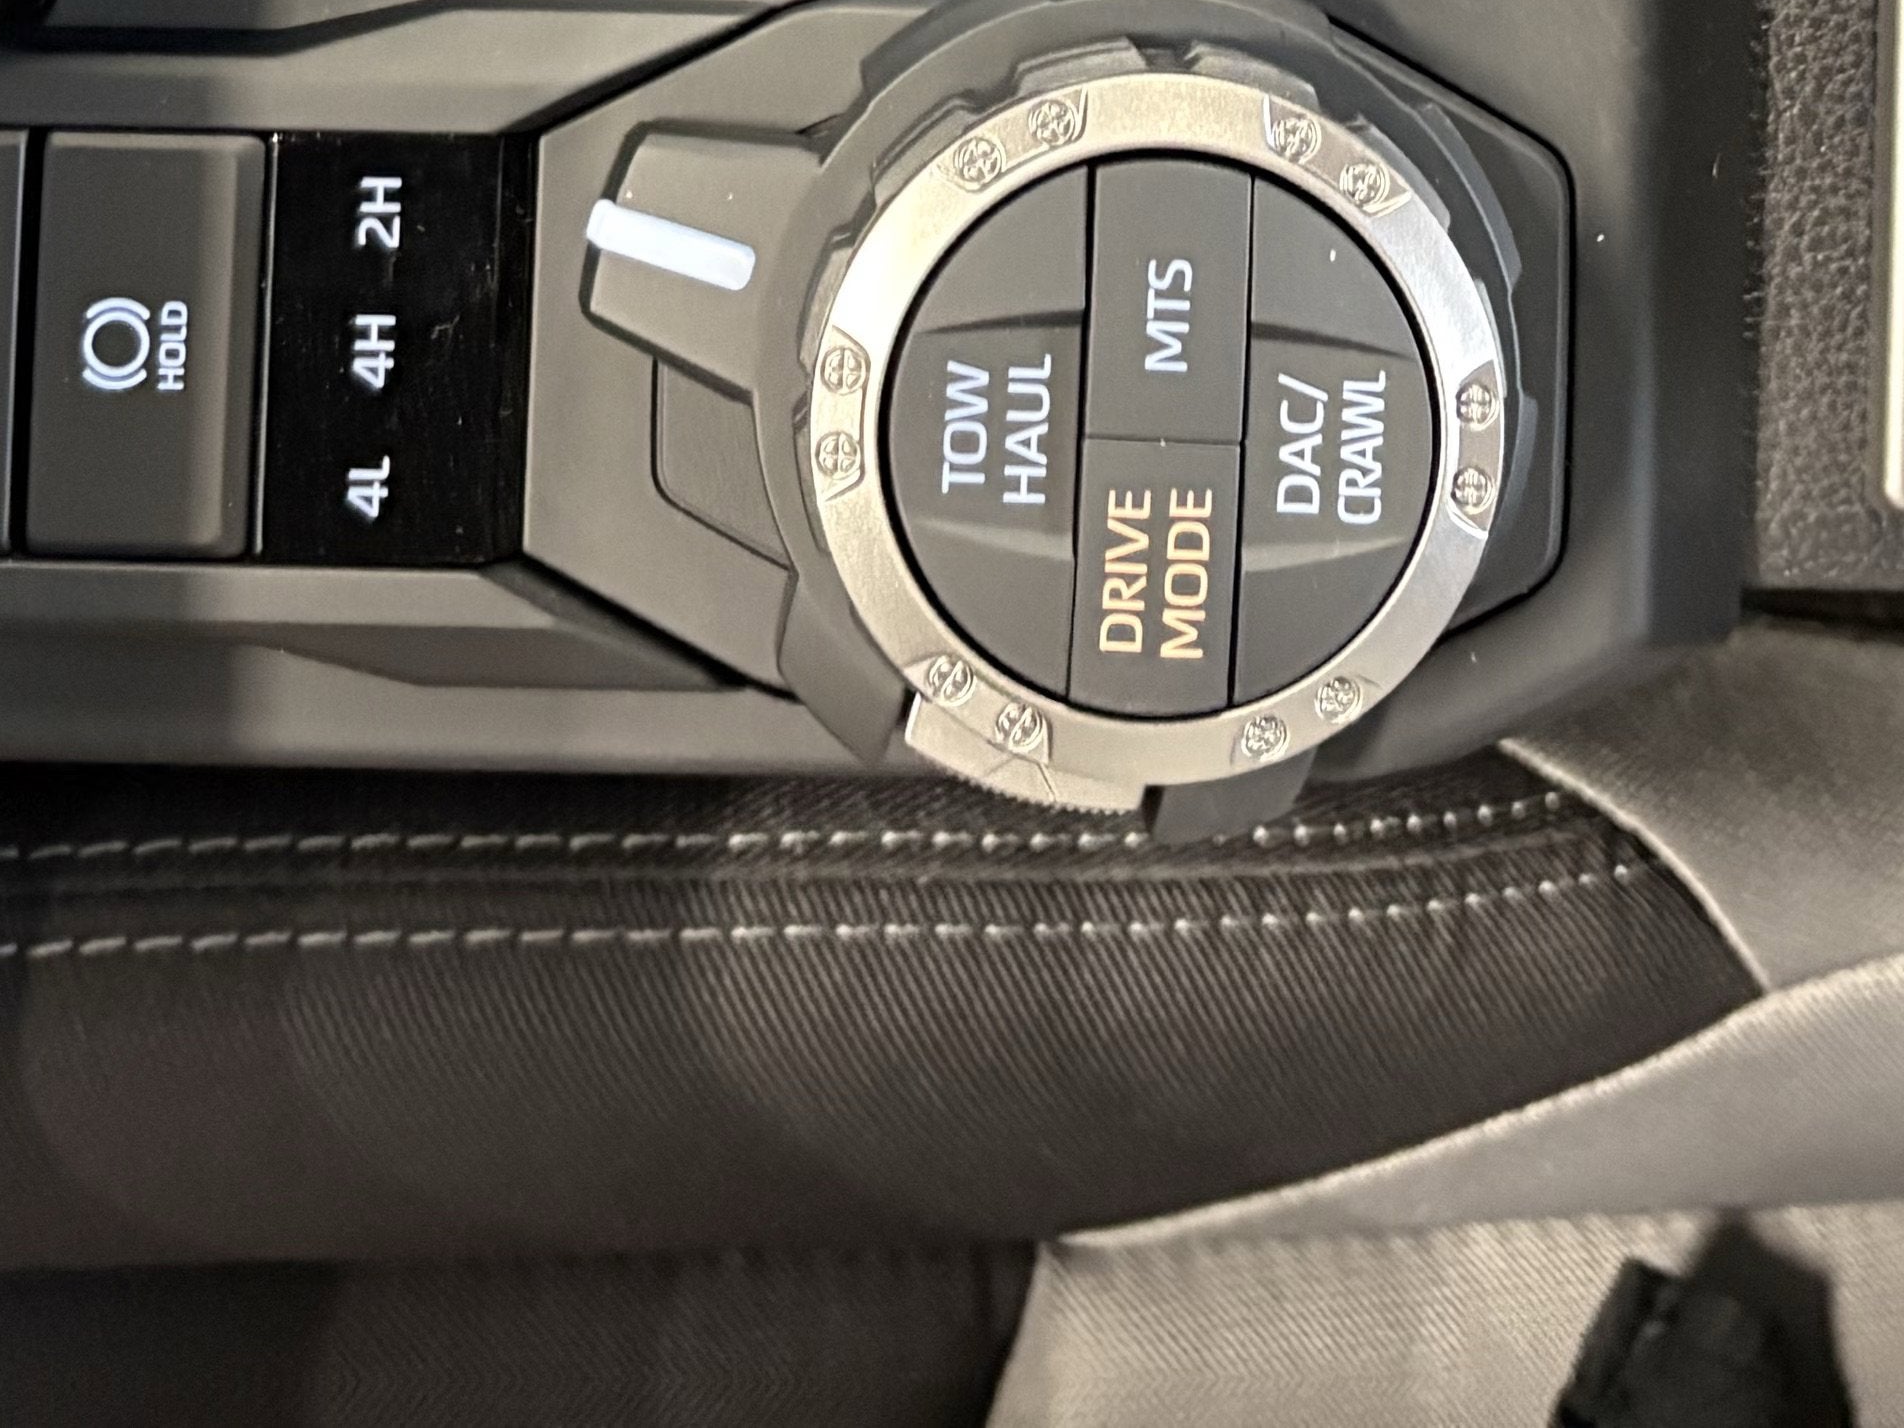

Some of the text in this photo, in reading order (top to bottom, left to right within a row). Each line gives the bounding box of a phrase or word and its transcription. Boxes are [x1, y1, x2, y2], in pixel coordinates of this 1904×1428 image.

[357, 176, 403, 249] 2H
[156, 300, 188, 391] HOLD
[351, 314, 397, 390] 4H
[1144, 259, 1193, 373] MTS
[346, 456, 391, 519] 4L
[941, 360, 990, 494] TOW
[1002, 353, 1052, 504] HAUL
[1276, 373, 1329, 515] DAC/
[1337, 369, 1387, 525] CRAWL
[1099, 489, 1152, 653] DRIVE
[1159, 487, 1213, 659] MODE
